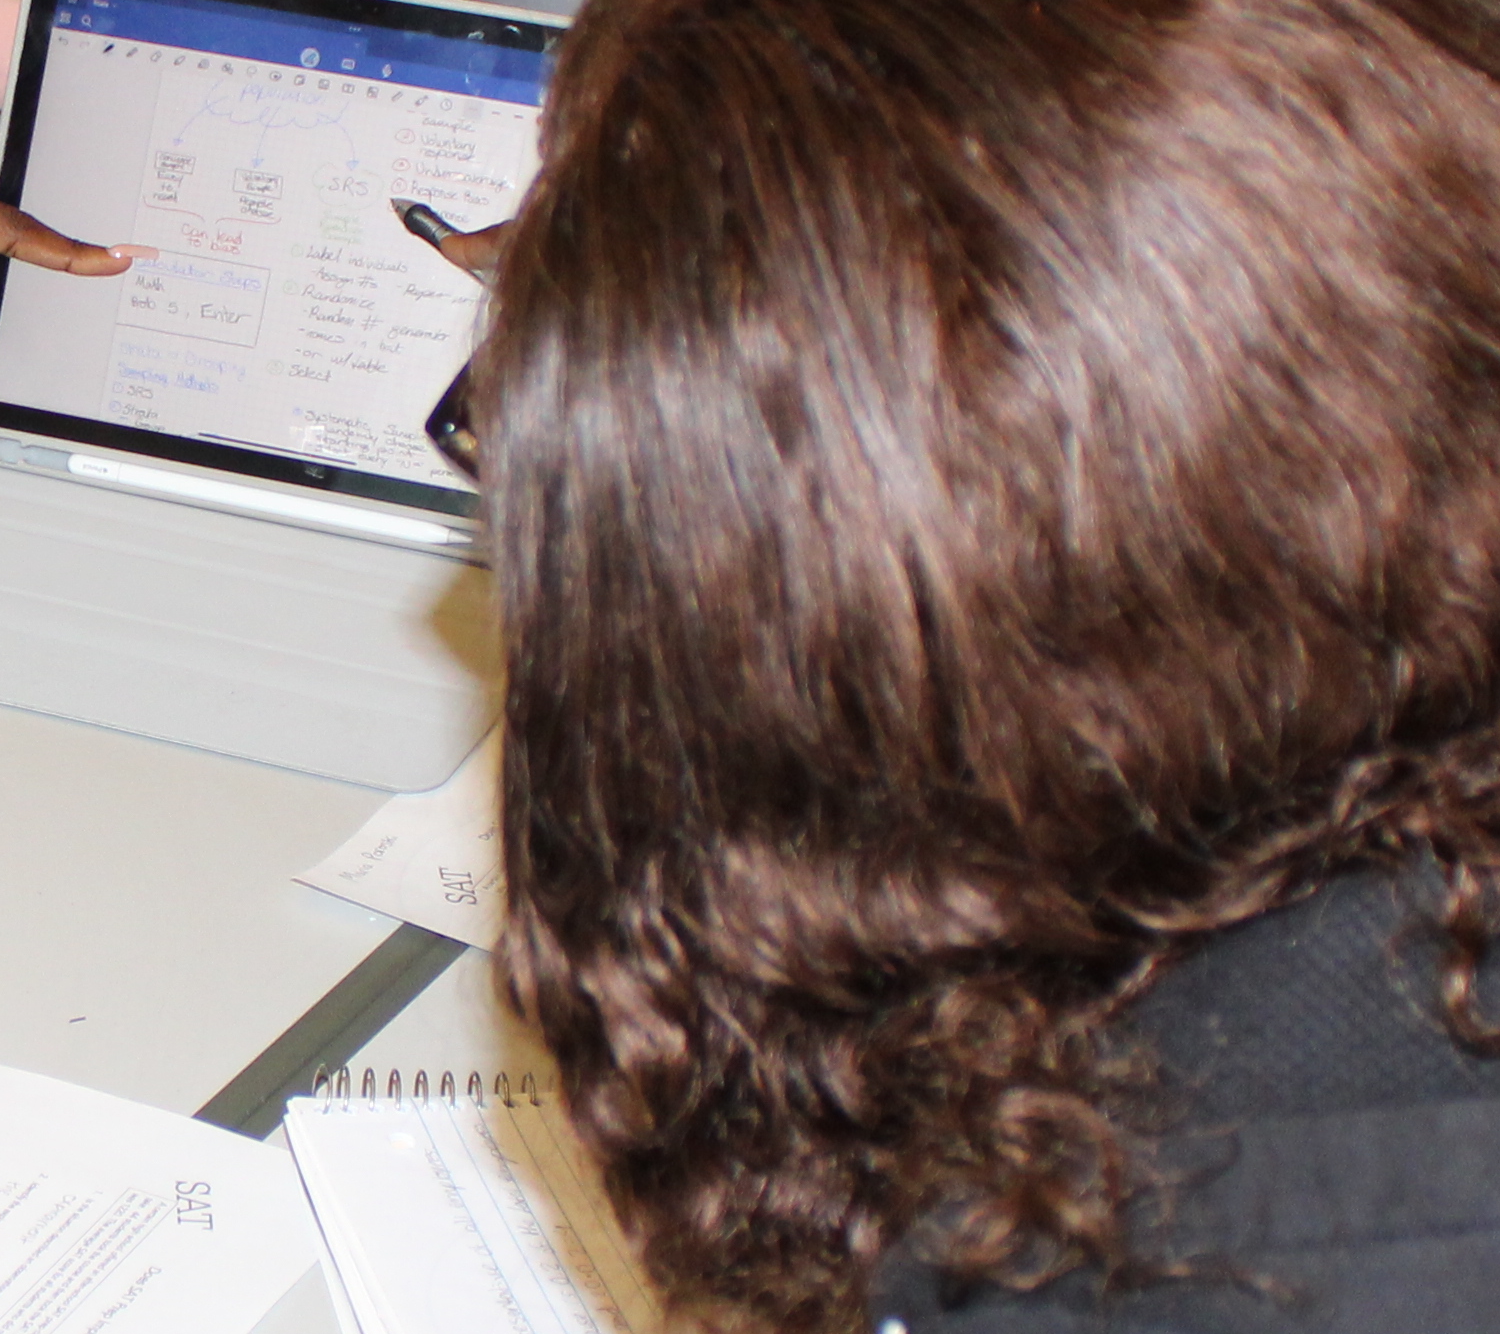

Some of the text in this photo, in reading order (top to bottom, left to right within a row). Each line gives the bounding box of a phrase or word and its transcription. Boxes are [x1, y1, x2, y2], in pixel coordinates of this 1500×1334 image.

[327, 175, 368, 197] SRS
[305, 244, 408, 273] Label individuals
[300, 283, 374, 310] Randomize
[199, 302, 251, 324] Enter
[287, 363, 331, 383] Select
[437, 865, 478, 906] SAT
[174, 1180, 214, 1231] SAT
[134, 1265, 162, 1286] Does
[121, 1284, 143, 1303] SAT
[100, 1301, 128, 1319] Prep
